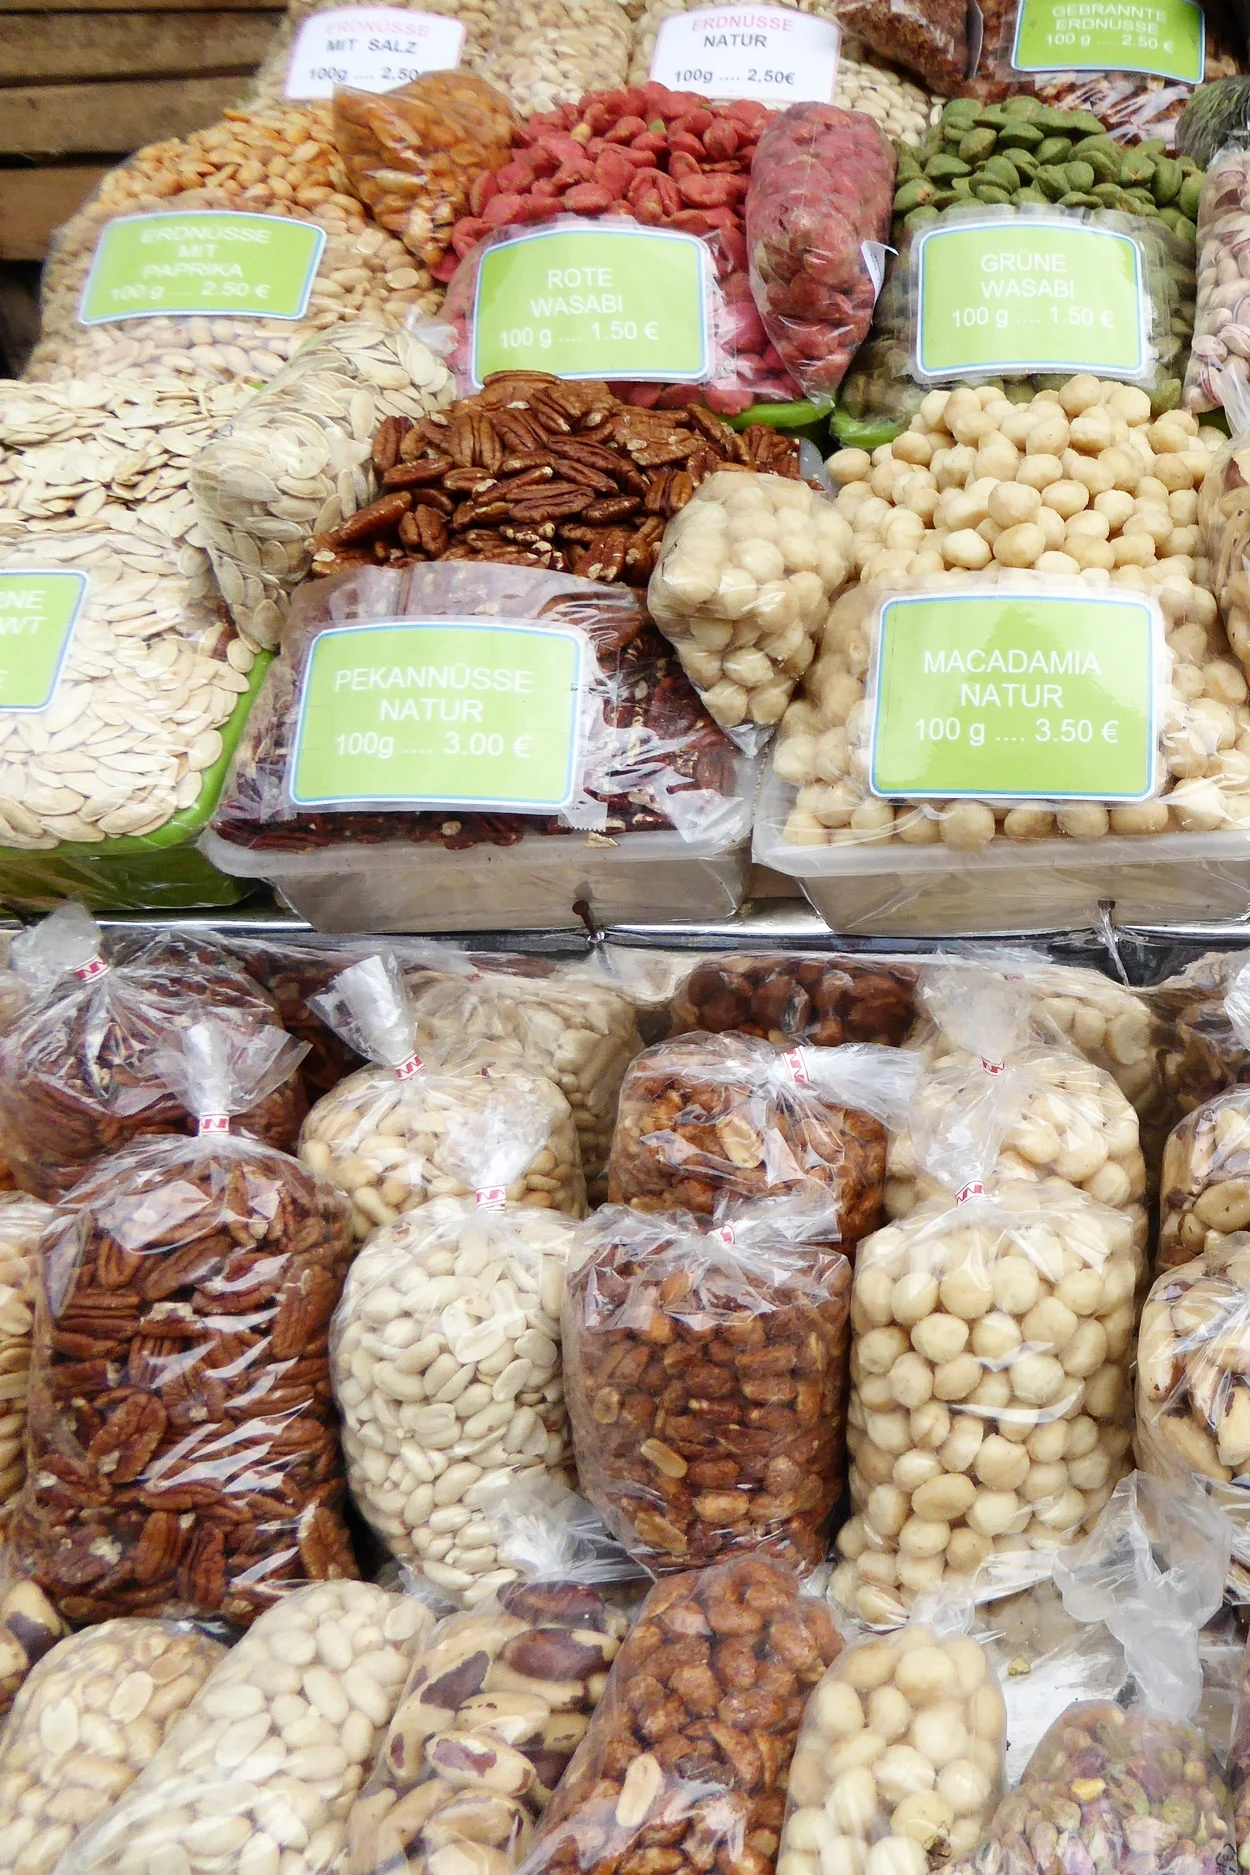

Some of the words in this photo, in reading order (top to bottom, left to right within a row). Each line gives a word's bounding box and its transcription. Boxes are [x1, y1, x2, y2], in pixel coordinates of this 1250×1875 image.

[692, 13, 793, 32] ERDNÜSSE
[327, 38, 357, 52] MIT
[368, 38, 417, 54] SALZ
[703, 34, 767, 48] NATUR
[1047, 32, 1075, 45] 100
[1080, 35, 1091, 47] g
[309, 67, 348, 82] 100g
[675, 69, 713, 84] 100g
[747, 69, 796, 85] 2,50€
[178, 245, 218, 258] MIT
[981, 248, 1066, 272] GRÜNE
[142, 263, 243, 279] PAPRIKA
[547, 267, 613, 289] ROTE
[111, 285, 146, 300] 100
[150, 286, 164, 300] g
[255, 285, 271, 299] €
[981, 279, 1074, 298] WASABI
[531, 294, 623, 317] WASABI
[953, 307, 988, 327] 100
[996, 309, 1008, 327] g
[1050, 305, 1093, 326] 1.50
[1101, 310, 1114, 328] €
[500, 327, 533, 348] 100
[540, 328, 552, 348] g
[592, 321, 637, 341] 1.50
[644, 321, 659, 340] €
[0, 590, 47, 609] NE
[923, 650, 1101, 675] MACADAMIA
[334, 663, 533, 693] PEKANNÜSSE
[960, 683, 1064, 708] NATUR
[380, 699, 484, 723] NATUR
[915, 717, 960, 741] 100
[969, 722, 985, 746] g
[1035, 719, 1093, 743] 3.50
[1101, 720, 1119, 744] €
[336, 732, 394, 759] 100g
[444, 732, 504, 756] 3.00
[513, 735, 532, 758] €
